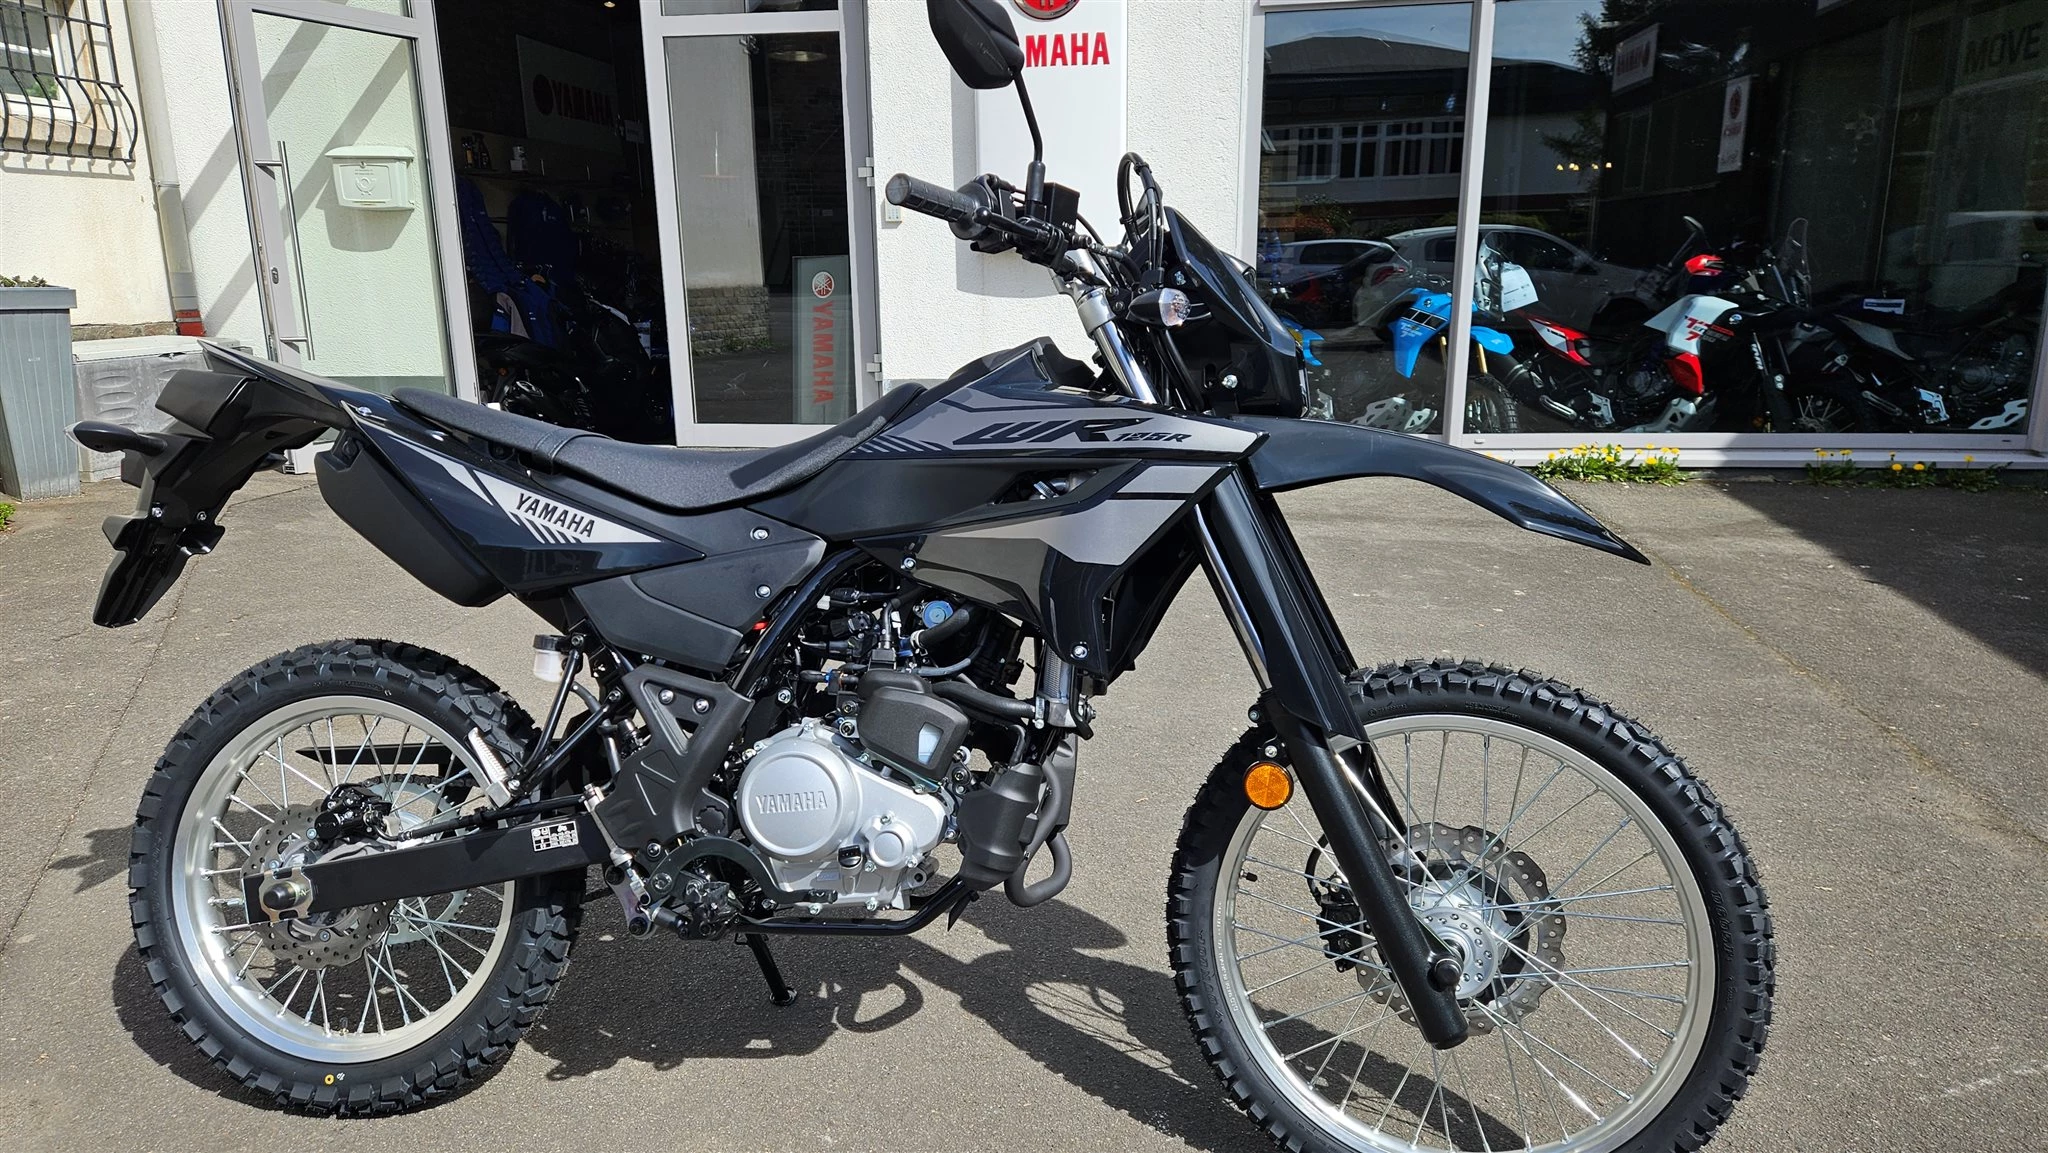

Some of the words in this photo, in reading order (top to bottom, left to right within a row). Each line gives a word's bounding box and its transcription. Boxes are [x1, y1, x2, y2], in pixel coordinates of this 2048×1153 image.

[1025, 31, 1110, 68] MAHA
[812, 300, 835, 404] YAMAHA
[952, 416, 1154, 446] WR
[1112, 431, 1192, 443] 125R
[516, 492, 595, 538] YAMAHA
[755, 790, 828, 815] YAMAHA
